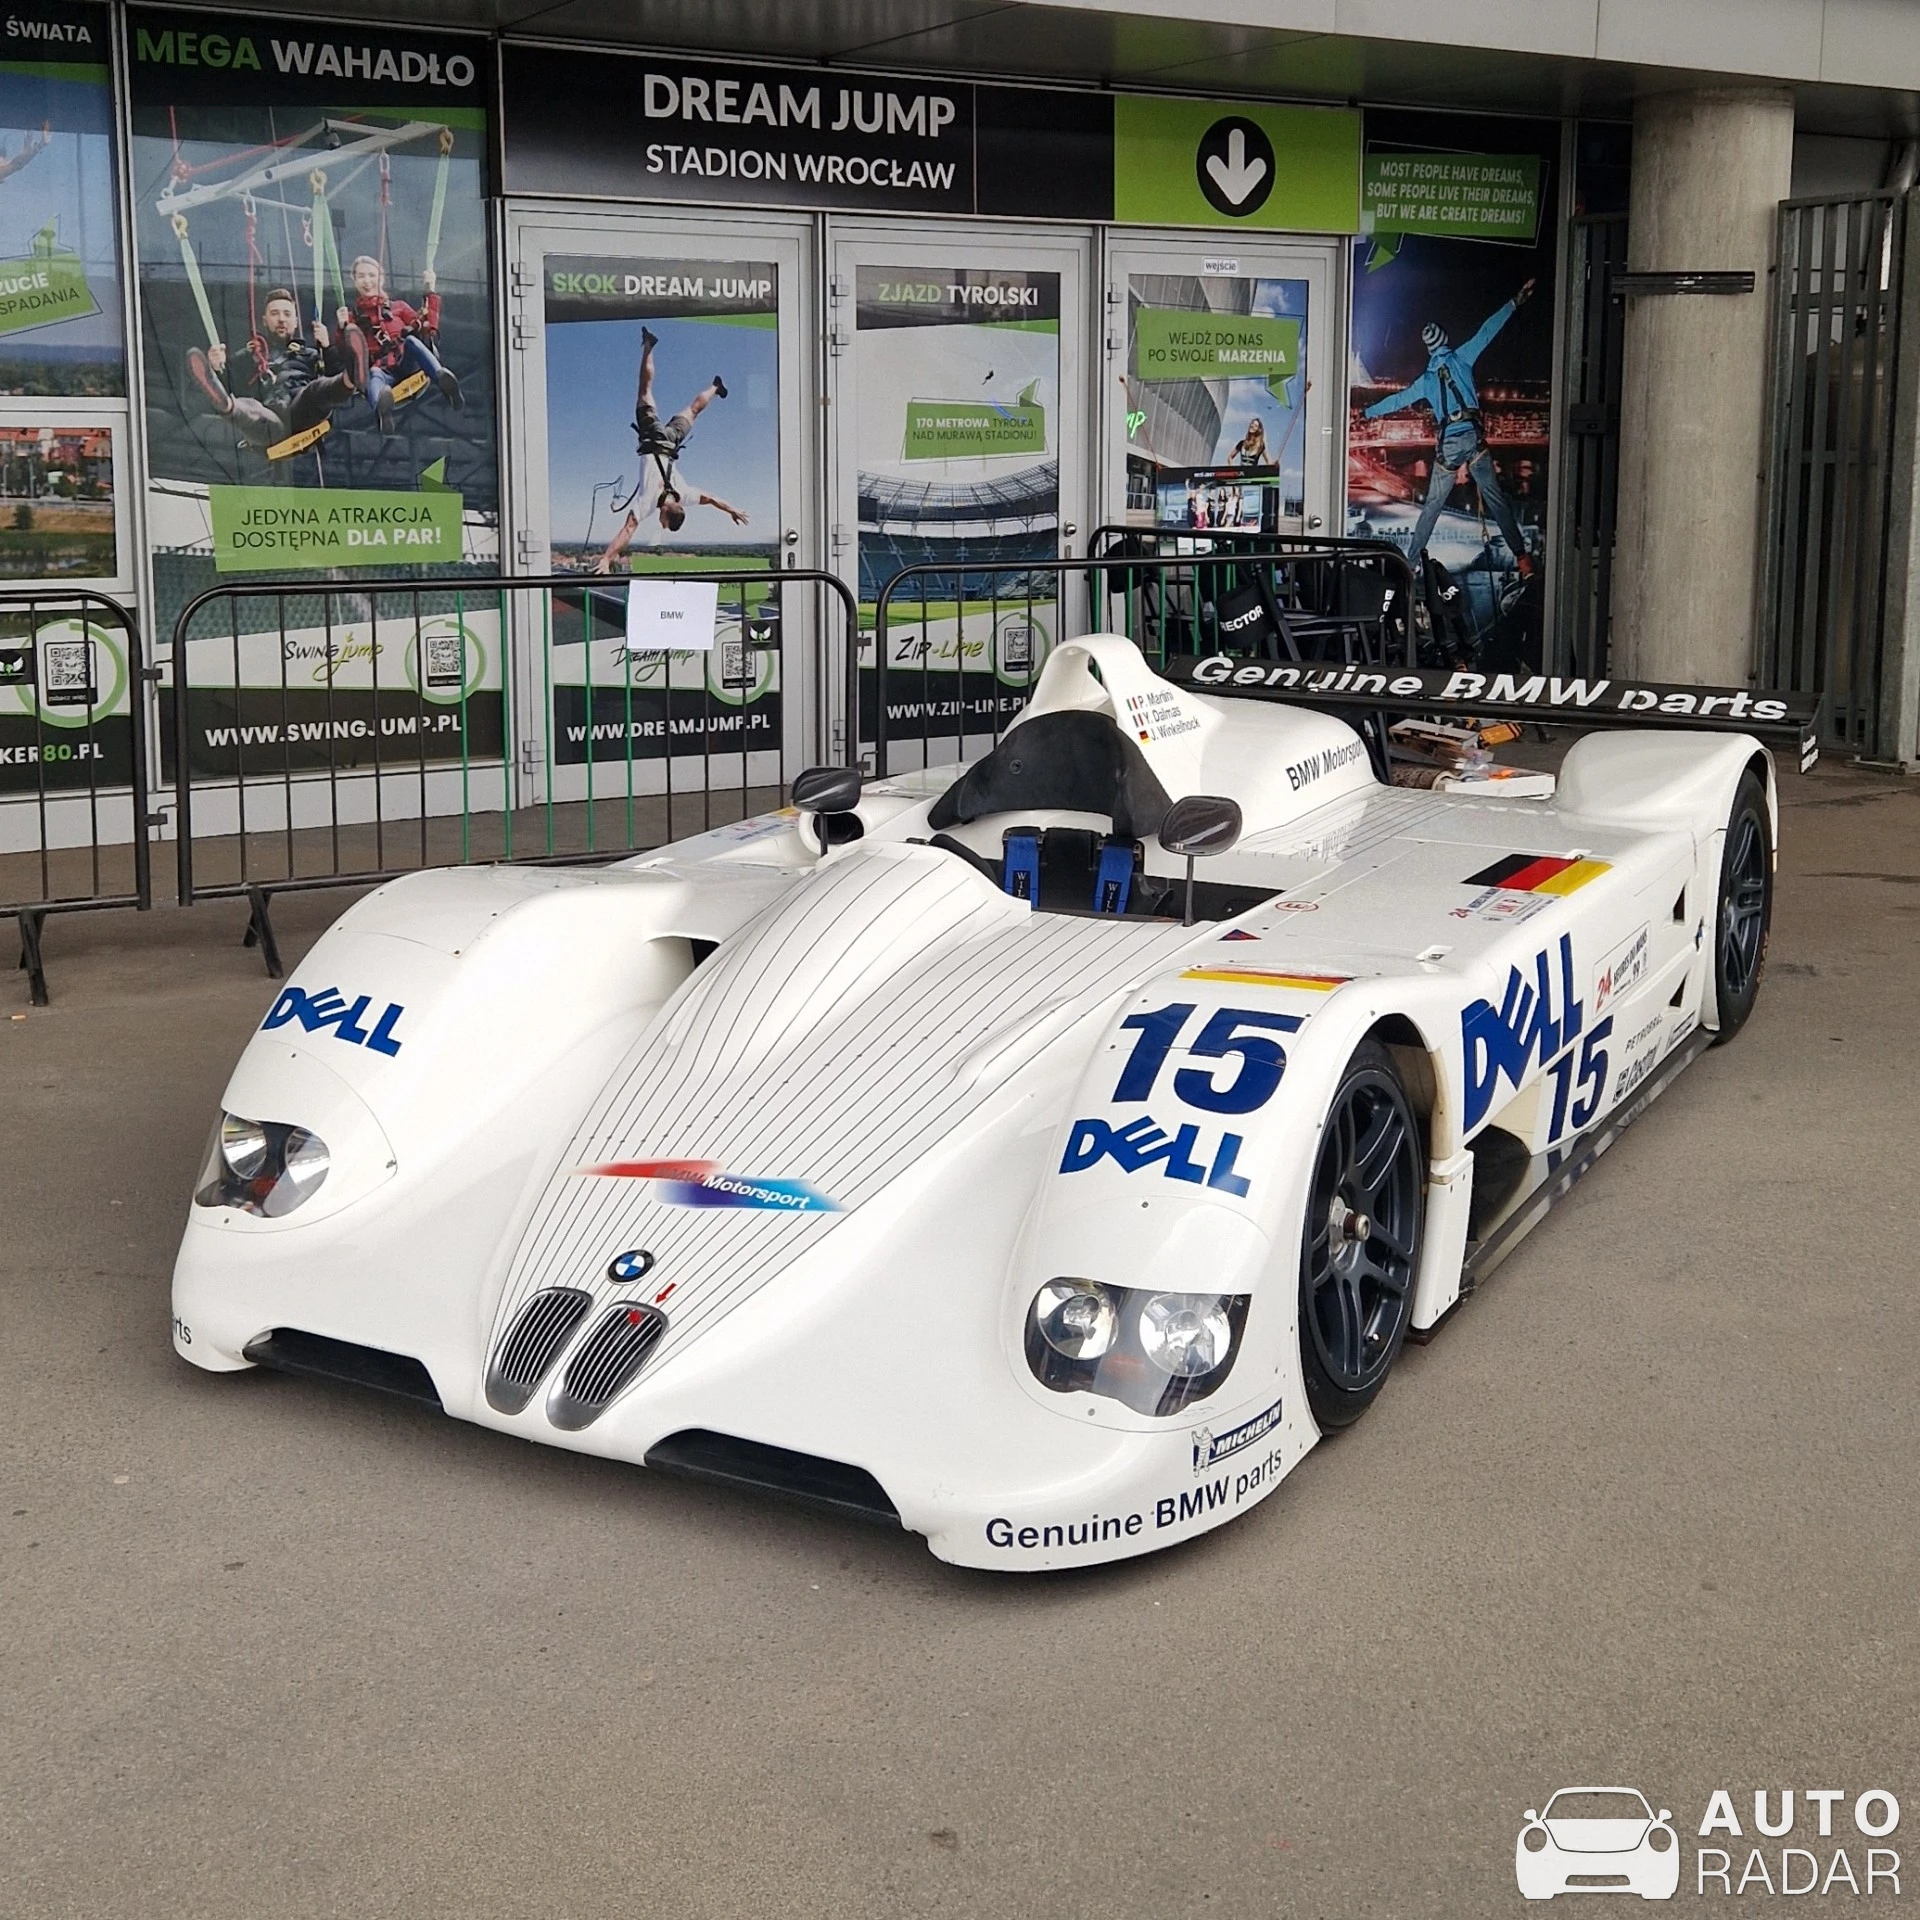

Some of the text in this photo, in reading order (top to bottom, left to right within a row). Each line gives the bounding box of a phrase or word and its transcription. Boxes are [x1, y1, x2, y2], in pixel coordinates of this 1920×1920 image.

[6, 16, 92, 44] ŚWIATA
[136, 28, 475, 87] MEGA WAHADŁO
[644, 74, 956, 138] DREAM JUMP
[646, 143, 956, 190] STADION WROCŁAW
[1380, 161, 1525, 187] MOST PEOPLE HAVE DREAMS,
[1367, 182, 1536, 207] SOME PEOPLE LIVE THEIR DREAMS,
[1376, 203, 1526, 225] BUT WE ARE CREATE DREAMS!
[1205, 261, 1237, 273] wejście
[552, 273, 772, 300] SKOK DREAM JUMP
[878, 282, 1039, 306] ZJAZD TYROLSKI
[1168, 329, 1263, 346] WEJDŹ DO NAS
[1148, 349, 1286, 363] PO SWOJE MARZENIA
[913, 430, 1037, 442] NAD MURAWĄ STADIONU!
[916, 417, 934, 428] 170
[935, 417, 990, 429] METROWA
[241, 507, 432, 526] JEDYNA ATRAKCJA
[232, 527, 442, 551] DOSTĘPNA DLA PAR!
[660, 611, 684, 620] BMW
[1192, 655, 1789, 721] Genuine BMW parts
[1152, 706, 1182, 723] Dalmas
[1285, 754, 1320, 792] BMW
[1105, 882, 1118, 913] WIL
[1595, 965, 1611, 1014] 24
[261, 986, 405, 1058] DELL
[1461, 931, 1583, 1137] DELL
[1110, 1002, 1306, 1115] 15
[1547, 1015, 1614, 1144] 15
[1059, 1115, 1252, 1199] DELL
[702, 1174, 811, 1209] Motorsport
[1215, 1402, 1281, 1456] MICHELIN
[985, 1447, 1282, 1547] Genuine BMW parts
